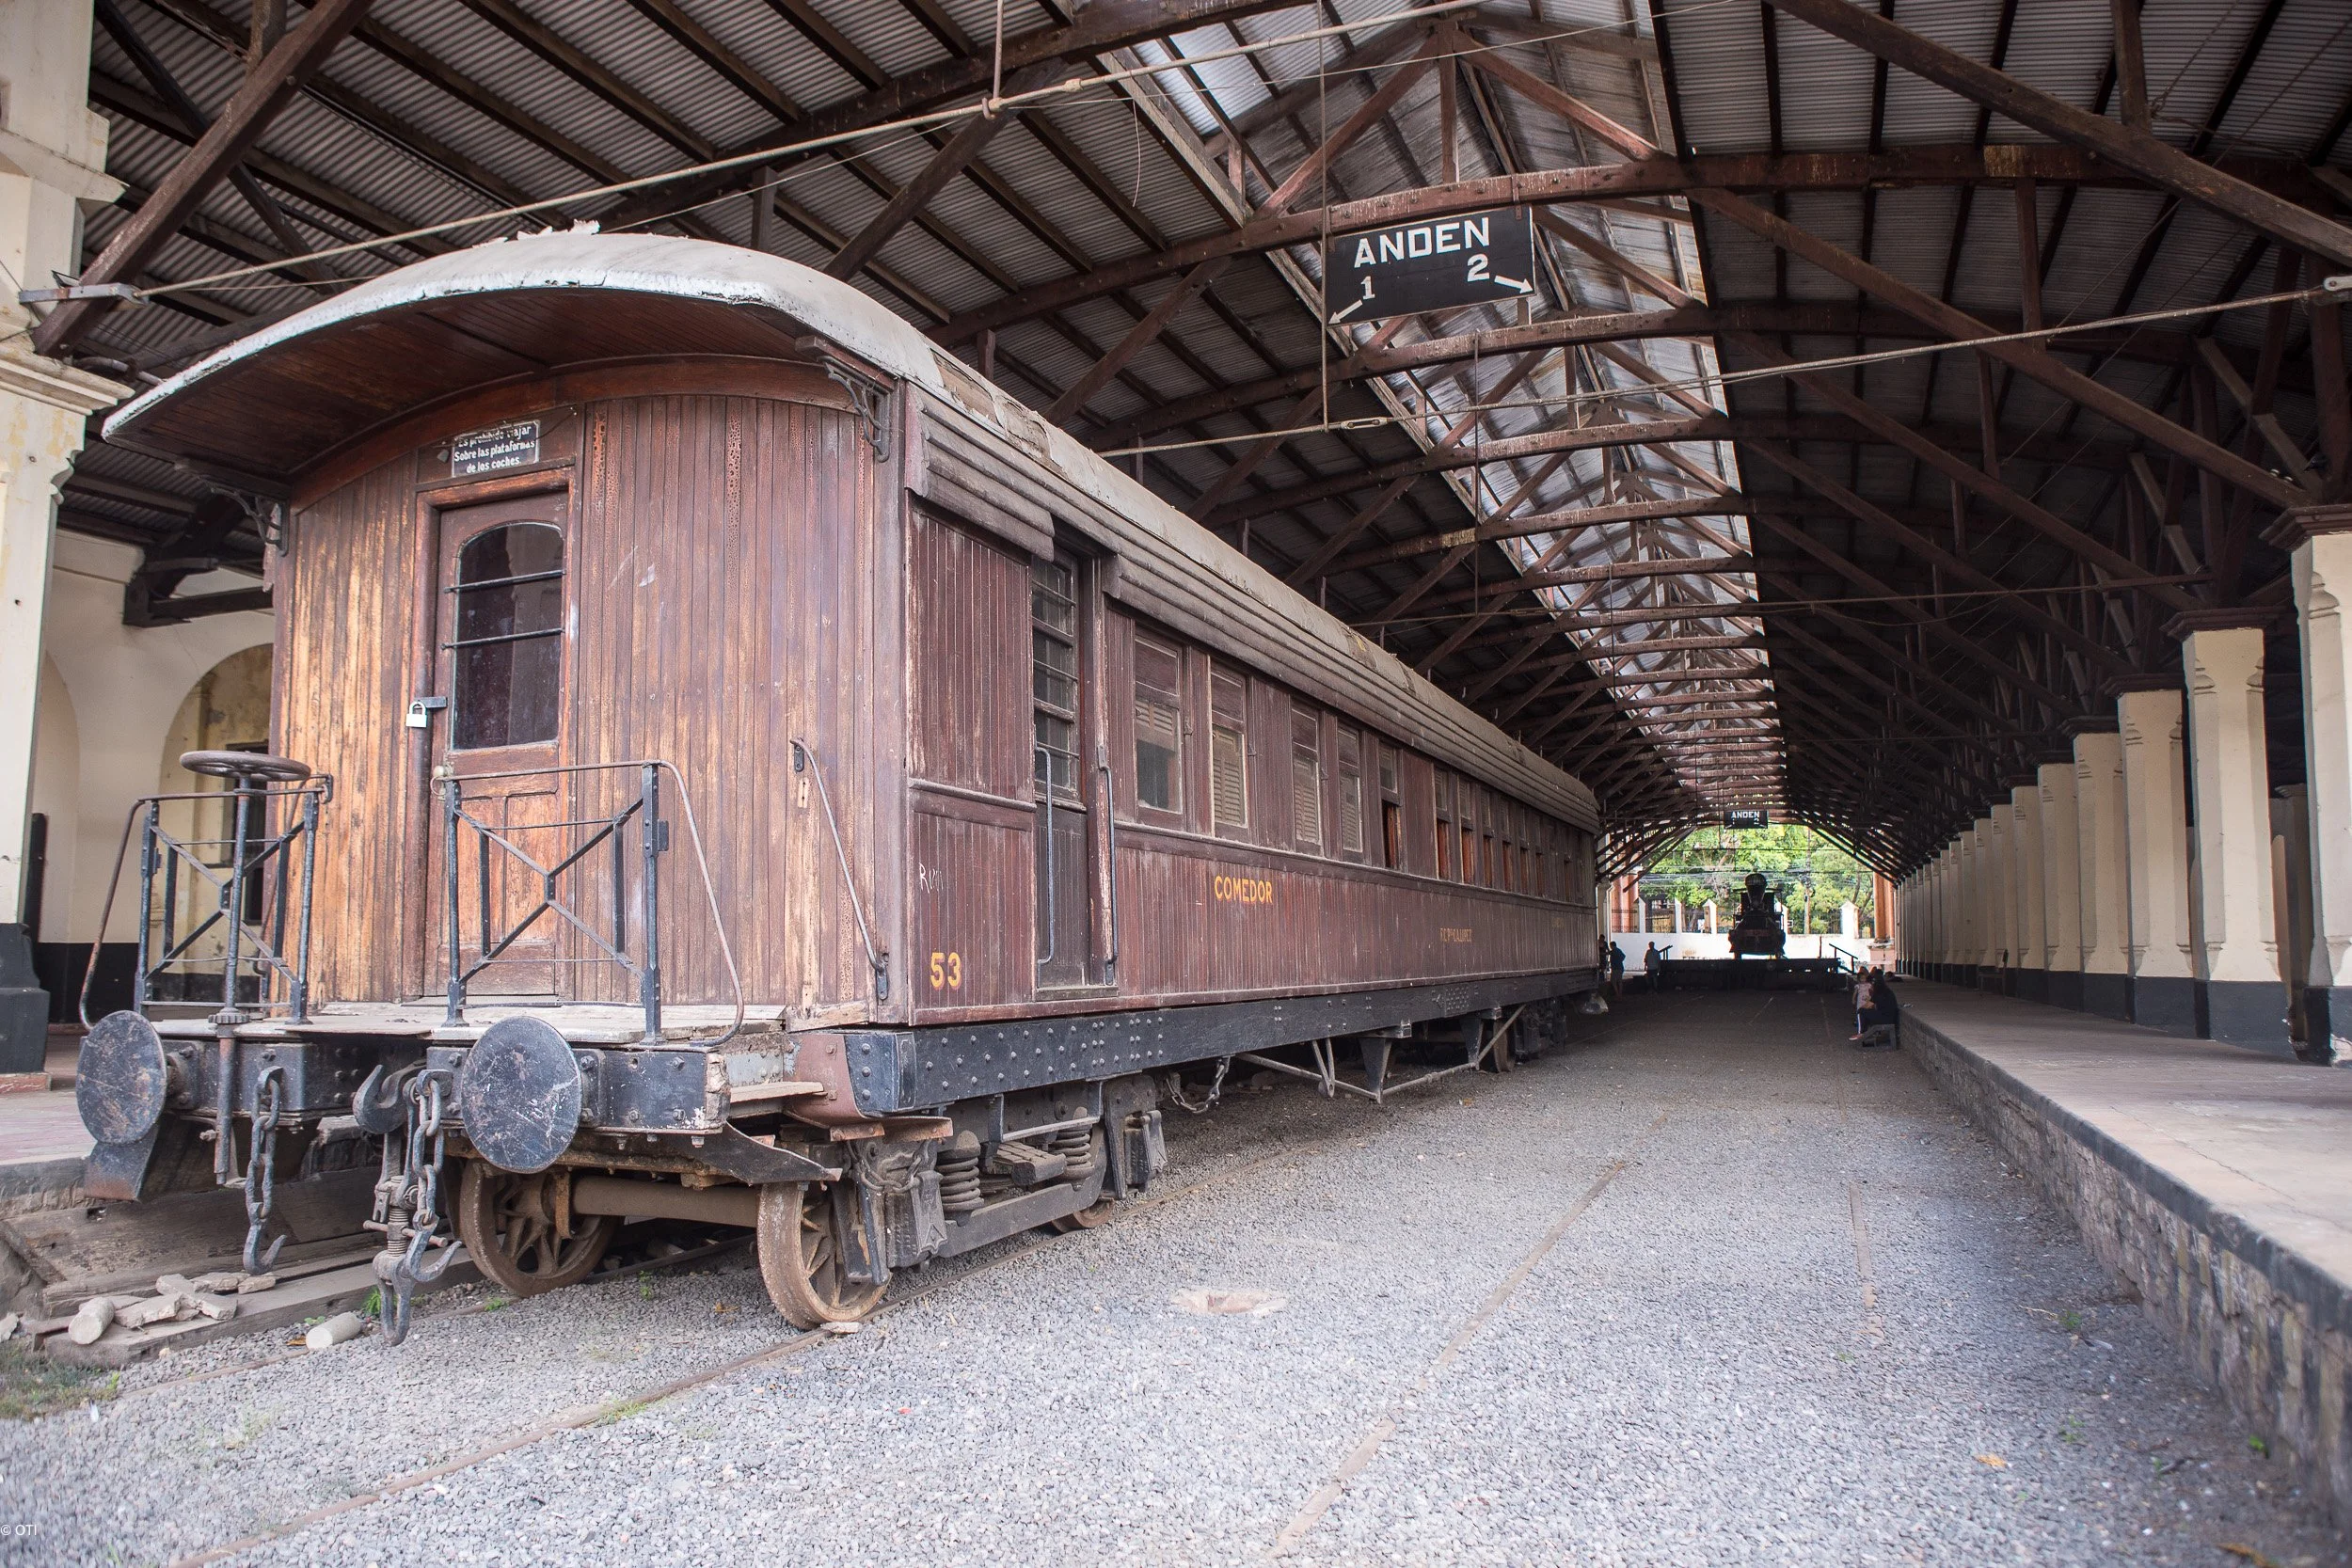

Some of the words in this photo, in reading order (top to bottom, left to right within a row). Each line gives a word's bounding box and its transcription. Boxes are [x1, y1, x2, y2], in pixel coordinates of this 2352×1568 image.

[1354, 217, 1490, 268] ANDEN
[1360, 276, 1375, 300] 1
[1467, 253, 1490, 282] 2
[453, 451, 477, 462] Sobre
[478, 447, 490, 458] las
[490, 439, 535, 458] plataformas
[467, 463, 477, 473] de
[478, 461, 490, 472] los
[1731, 811, 1760, 819] ANDEN
[1215, 875, 1273, 904] COMEDOR
[930, 952, 962, 990] 53
